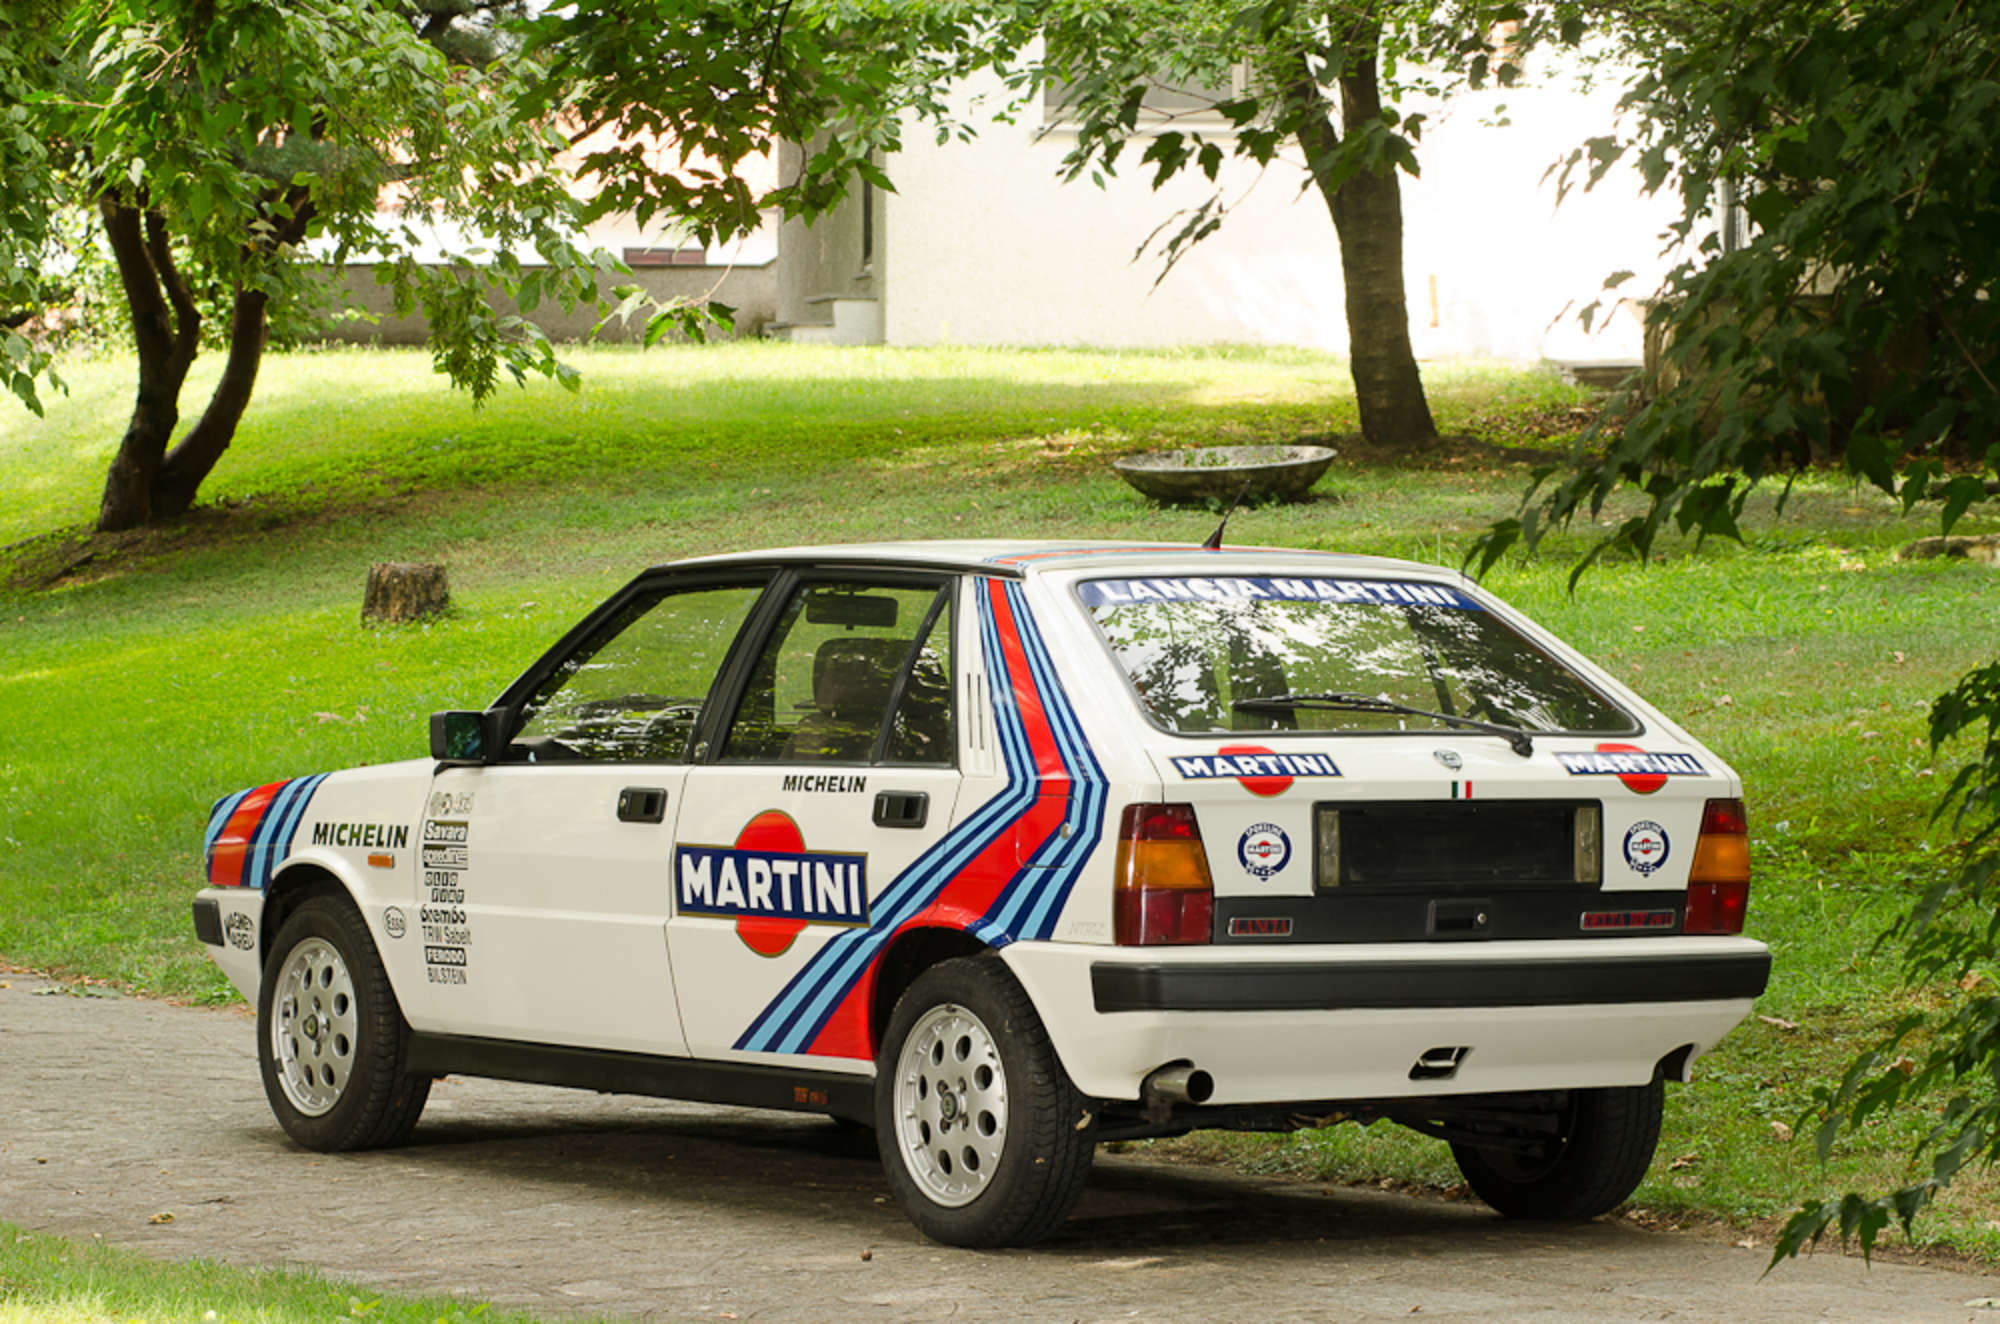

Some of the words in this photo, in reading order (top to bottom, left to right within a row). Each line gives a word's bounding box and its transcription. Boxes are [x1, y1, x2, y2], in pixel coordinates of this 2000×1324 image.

[1096, 580, 1271, 601] LANCIA
[1269, 579, 1460, 606] MARTINI
[1174, 755, 1338, 778] MARTINI
[1558, 754, 1704, 775] MARTINI
[782, 775, 867, 793] MICHELIN
[312, 822, 409, 849] MICHELIN
[680, 853, 861, 916] MARTINI
[420, 903, 467, 925] brembo
